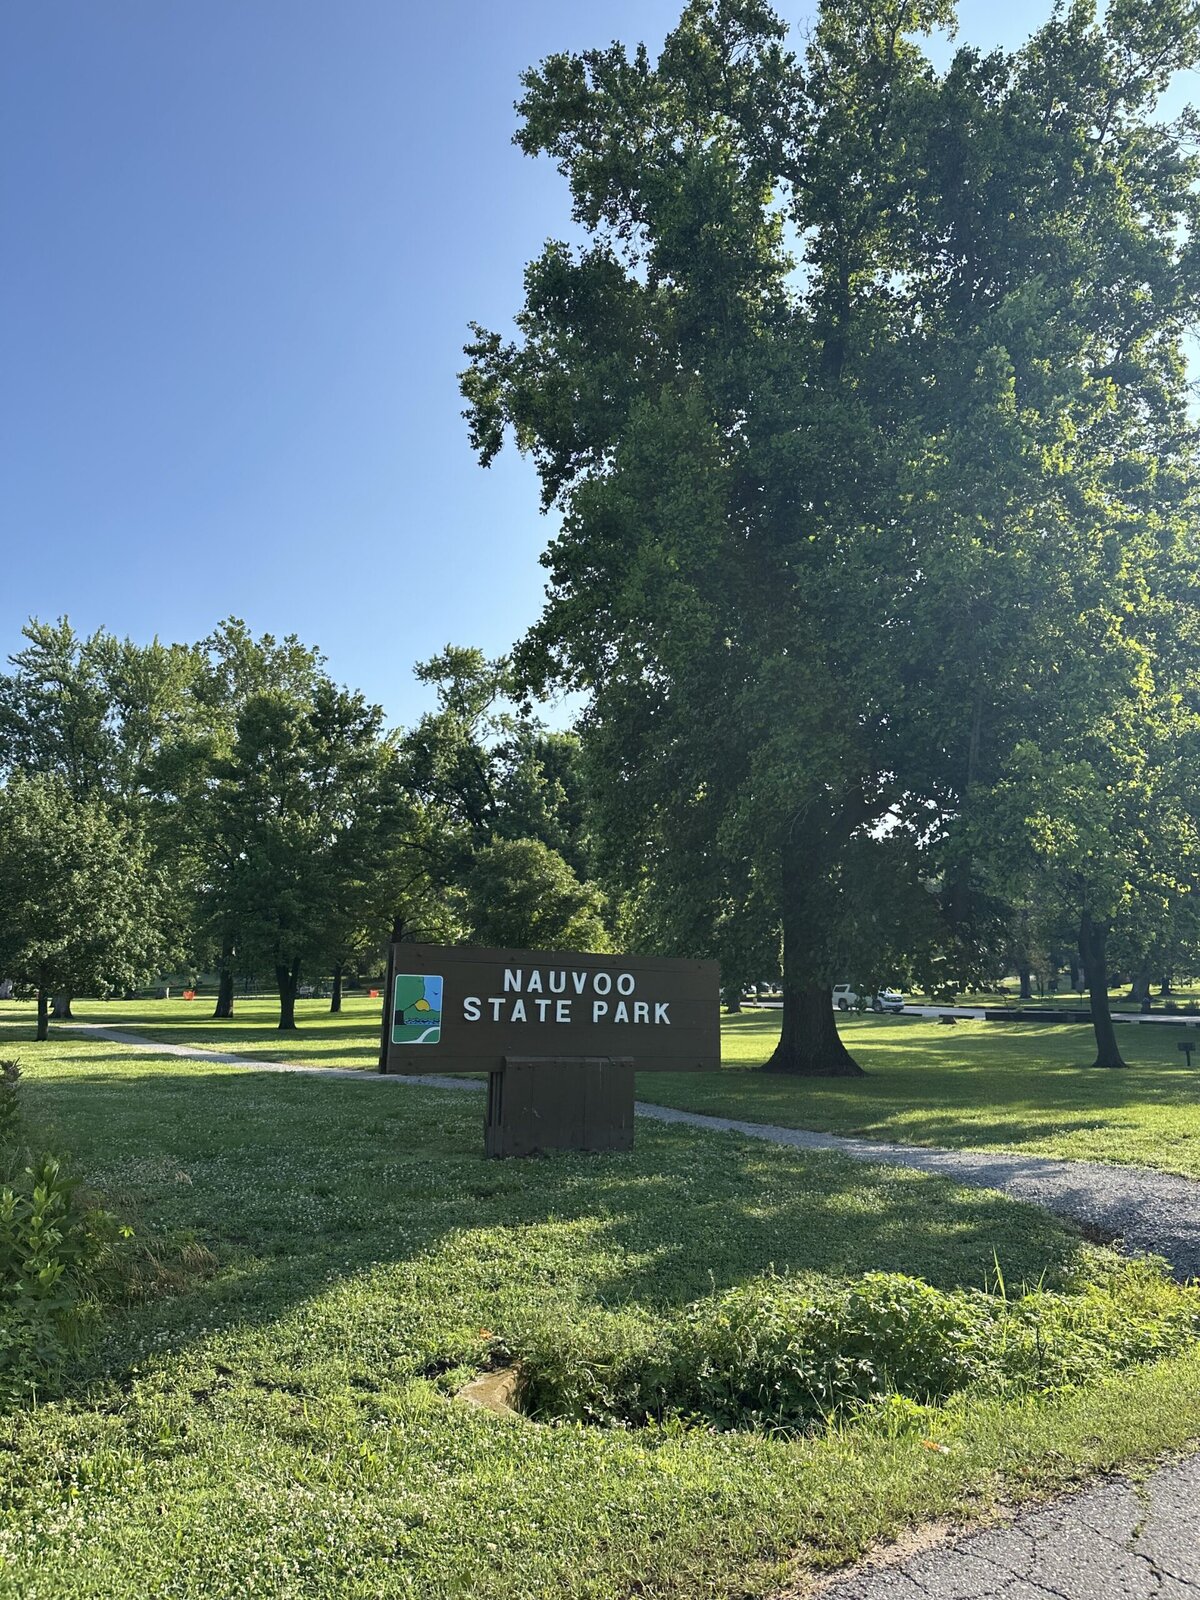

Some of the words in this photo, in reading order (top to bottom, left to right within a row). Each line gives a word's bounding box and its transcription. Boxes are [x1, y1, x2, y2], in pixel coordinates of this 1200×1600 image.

[503, 968, 636, 996] NAUVOO
[463, 997, 572, 1023] STATE
[592, 1001, 672, 1025] PARK
